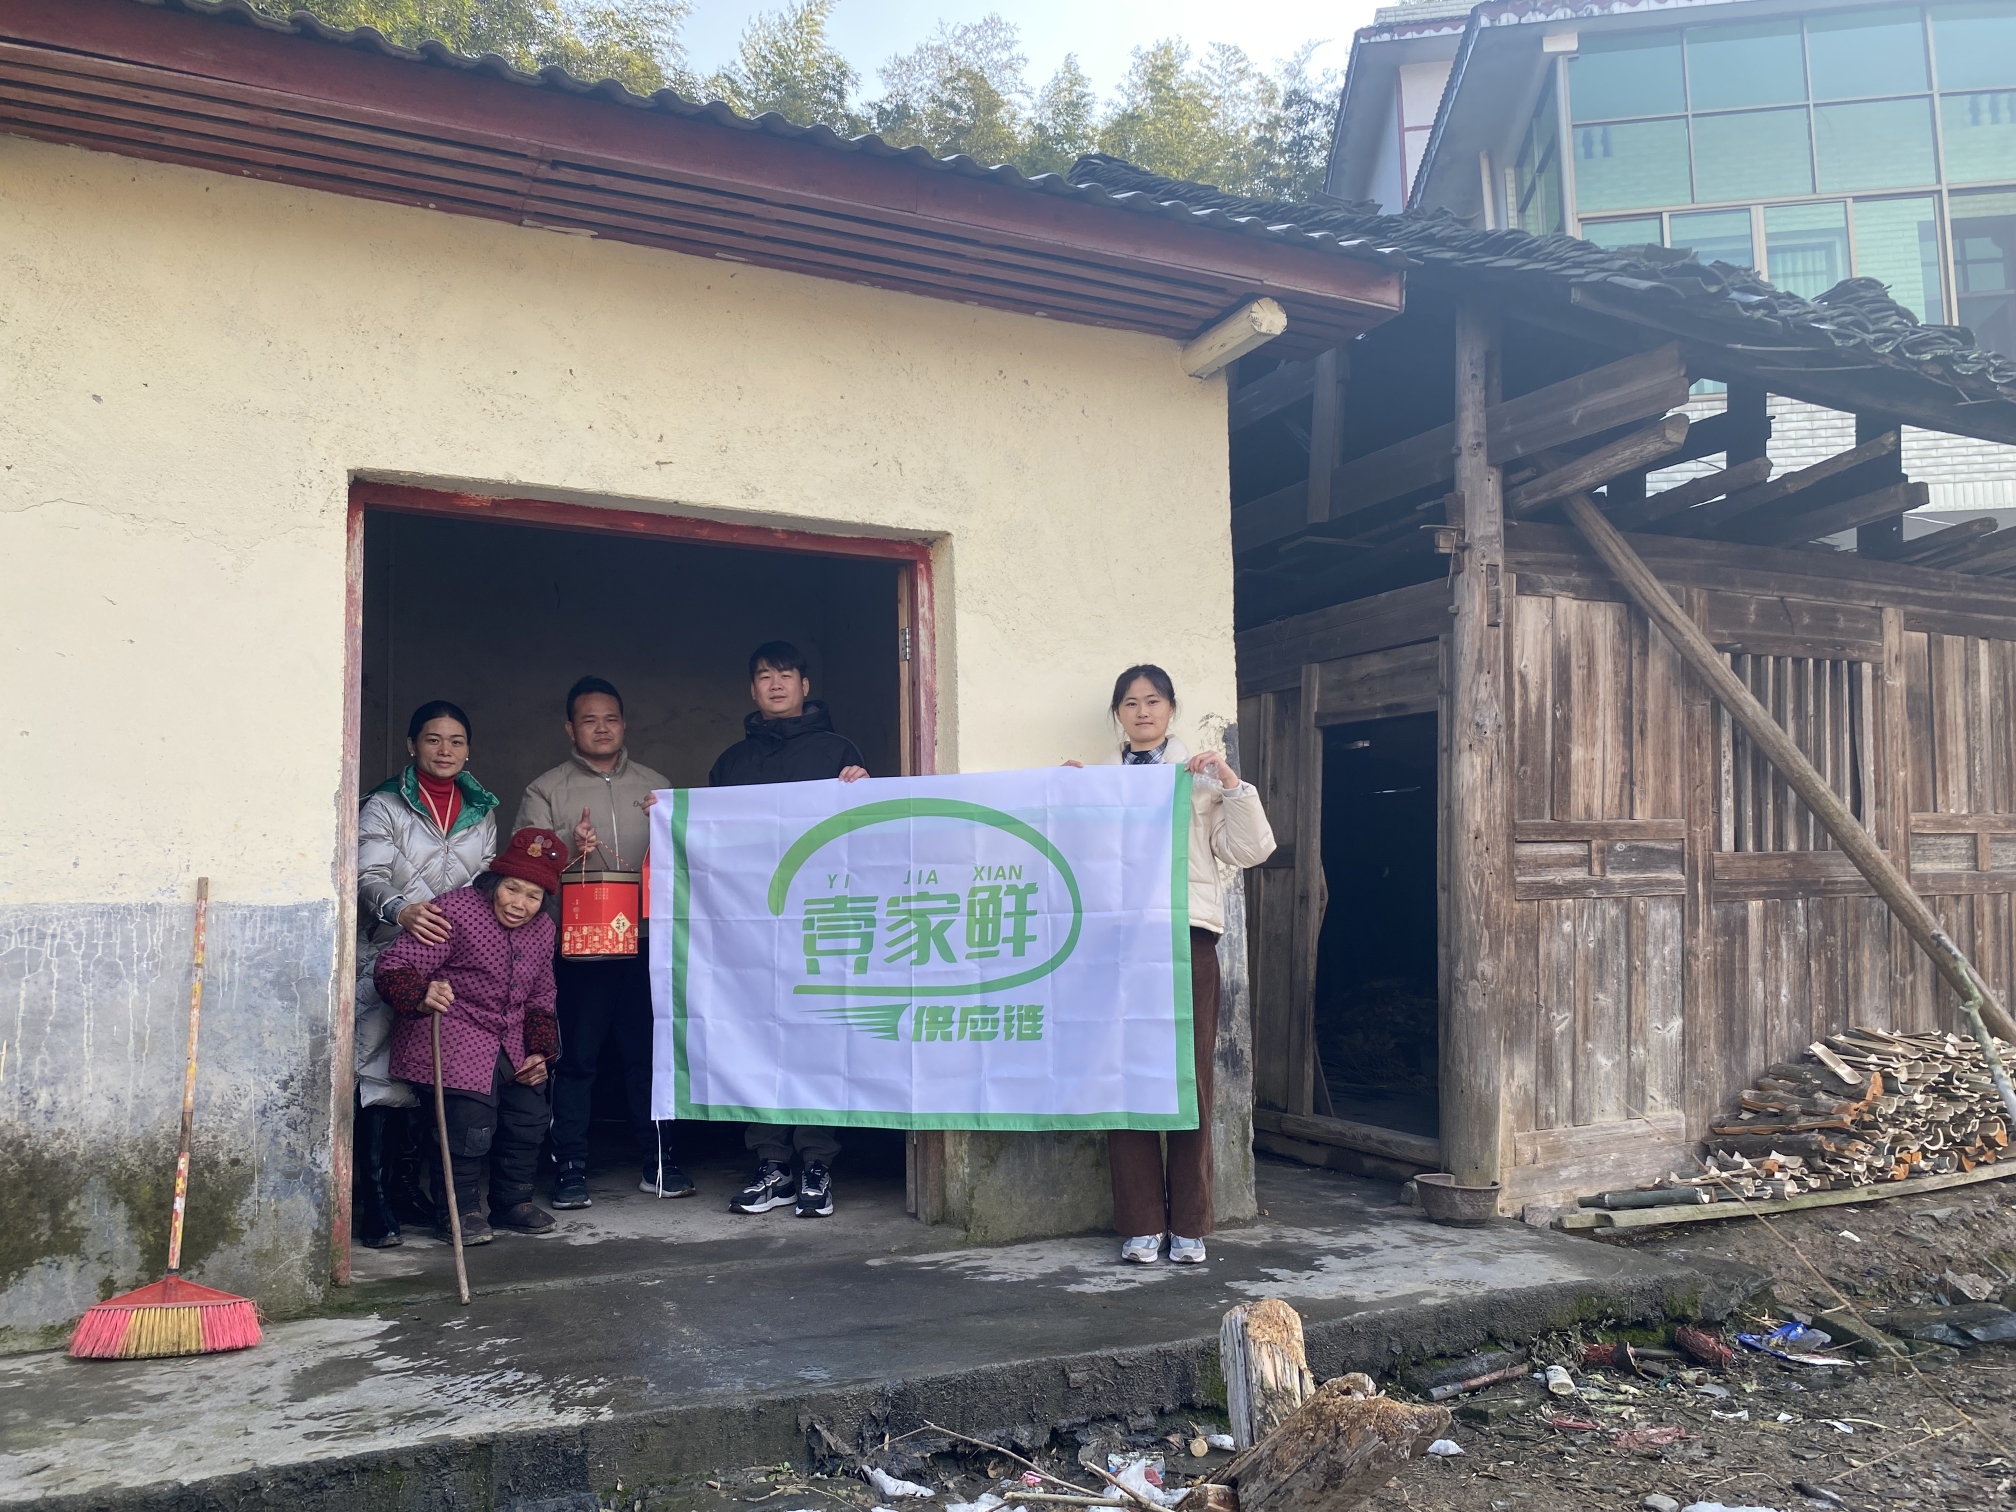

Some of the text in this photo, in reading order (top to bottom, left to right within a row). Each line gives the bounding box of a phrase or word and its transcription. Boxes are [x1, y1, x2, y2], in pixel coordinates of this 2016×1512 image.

[827, 864, 1023, 888] YI JIA XIAN
[802, 882, 1039, 975] 壹家鲜
[911, 1004, 1044, 1042] 供应链
